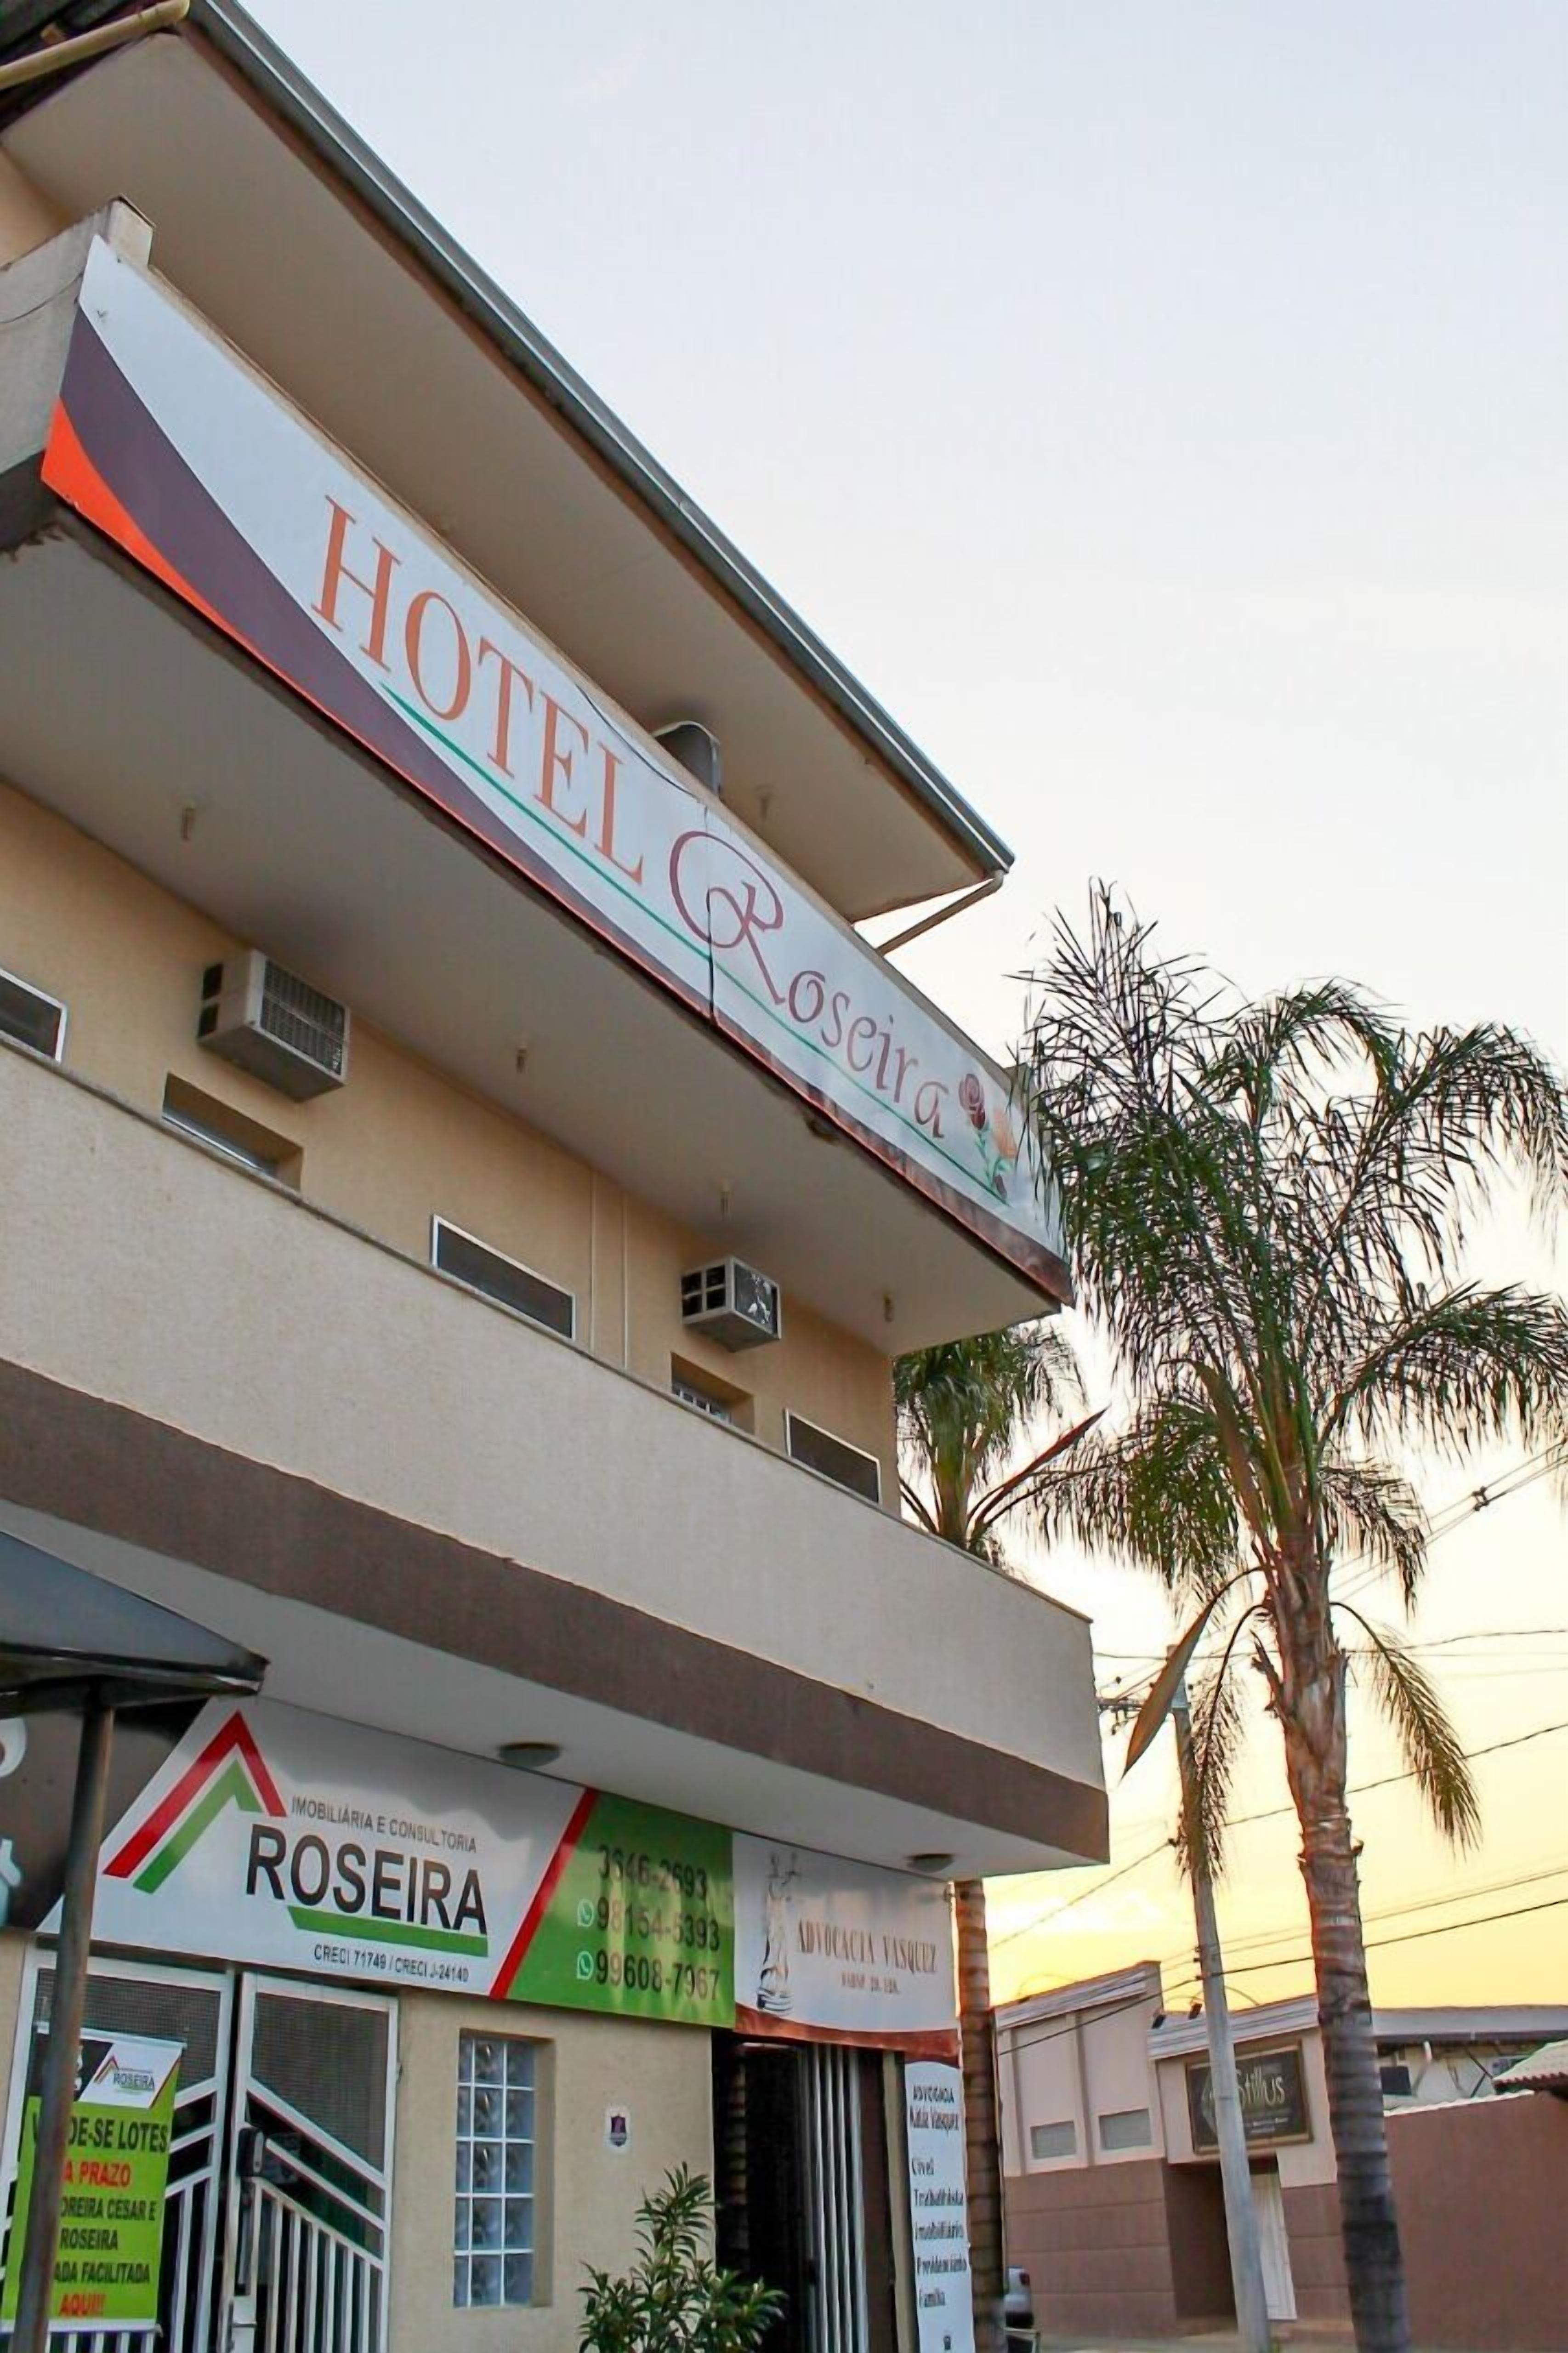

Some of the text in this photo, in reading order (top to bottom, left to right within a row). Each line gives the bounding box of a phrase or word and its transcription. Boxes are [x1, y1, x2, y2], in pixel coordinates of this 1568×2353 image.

[311, 494, 949, 1138] HOTEL Roseira
[292, 1796, 374, 1832] IMOBILIÁRIA
[376, 1816, 386, 1834] E
[246, 1823, 488, 1935] ROSEIRA
[314, 1944, 350, 1965] CRECI
[395, 1957, 427, 1978] CRECI
[596, 1949, 720, 2001] 99608-7967
[117, 2121, 168, 2153] LOTES
[79, 2161, 131, 2187] PRAZO
[60, 2196, 104, 2219] OREIRA
[59, 2228, 119, 2251] ROSEIRA
